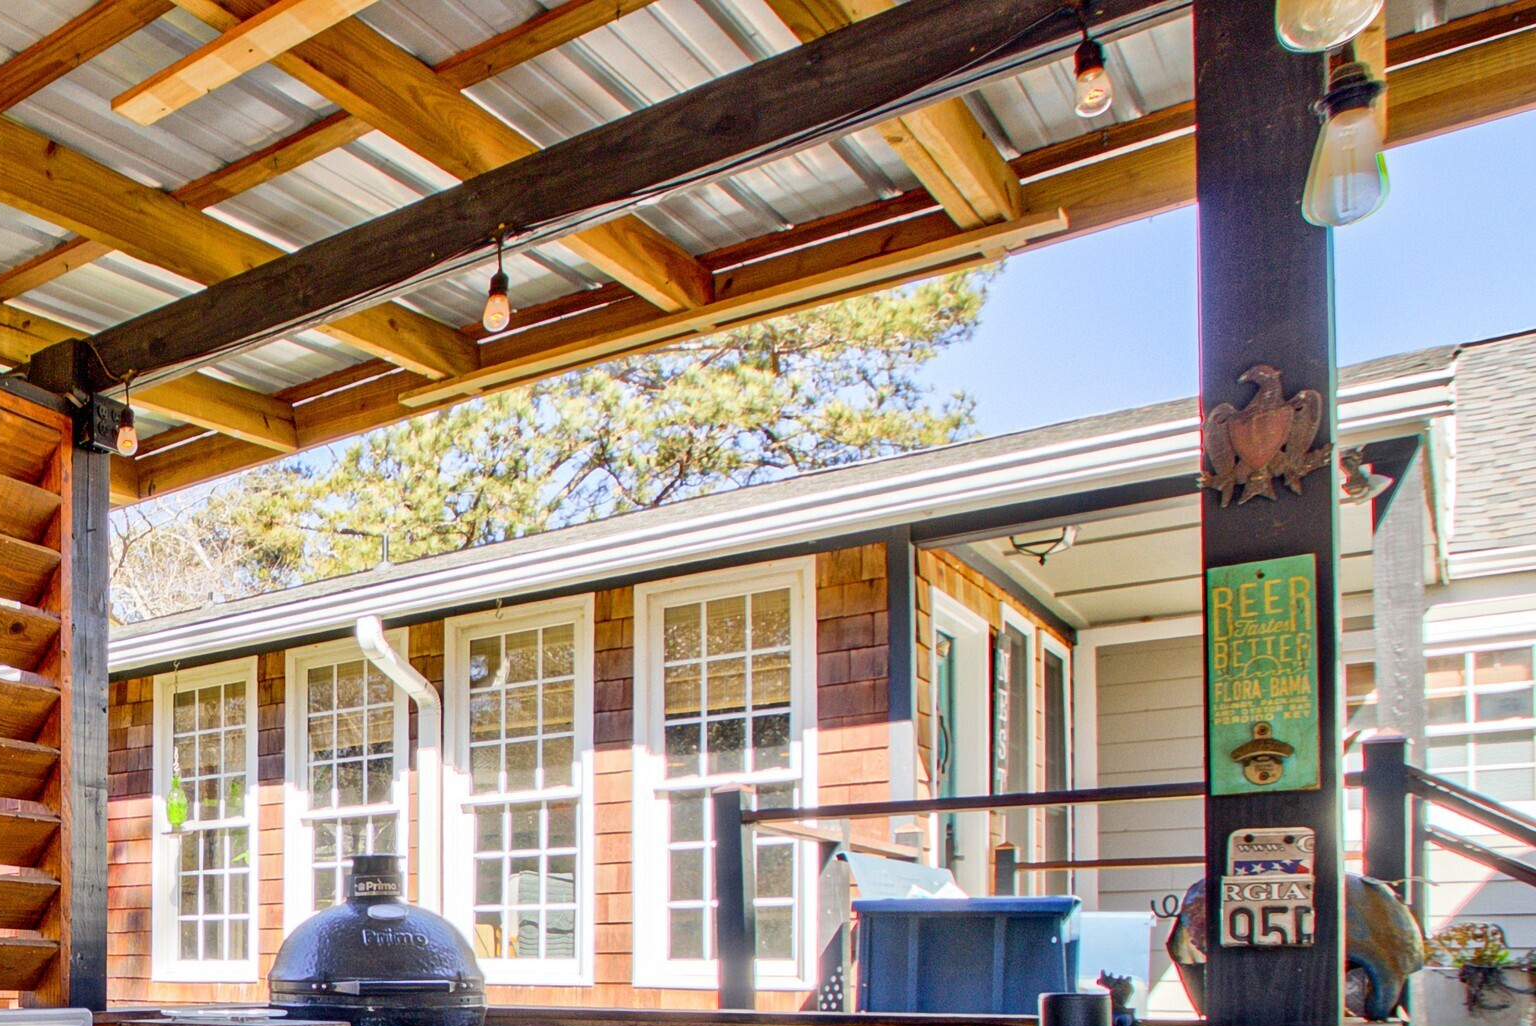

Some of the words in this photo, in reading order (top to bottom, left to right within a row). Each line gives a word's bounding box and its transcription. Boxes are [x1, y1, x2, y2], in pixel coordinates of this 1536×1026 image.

[1213, 576, 1311, 641] BEER
[1234, 618, 1291, 637] Tastes
[1215, 632, 1311, 669] BETTER
[1284, 710, 1311, 719] KEY
[366, 878, 397, 891] Primo
[362, 929, 430, 946] Primo
